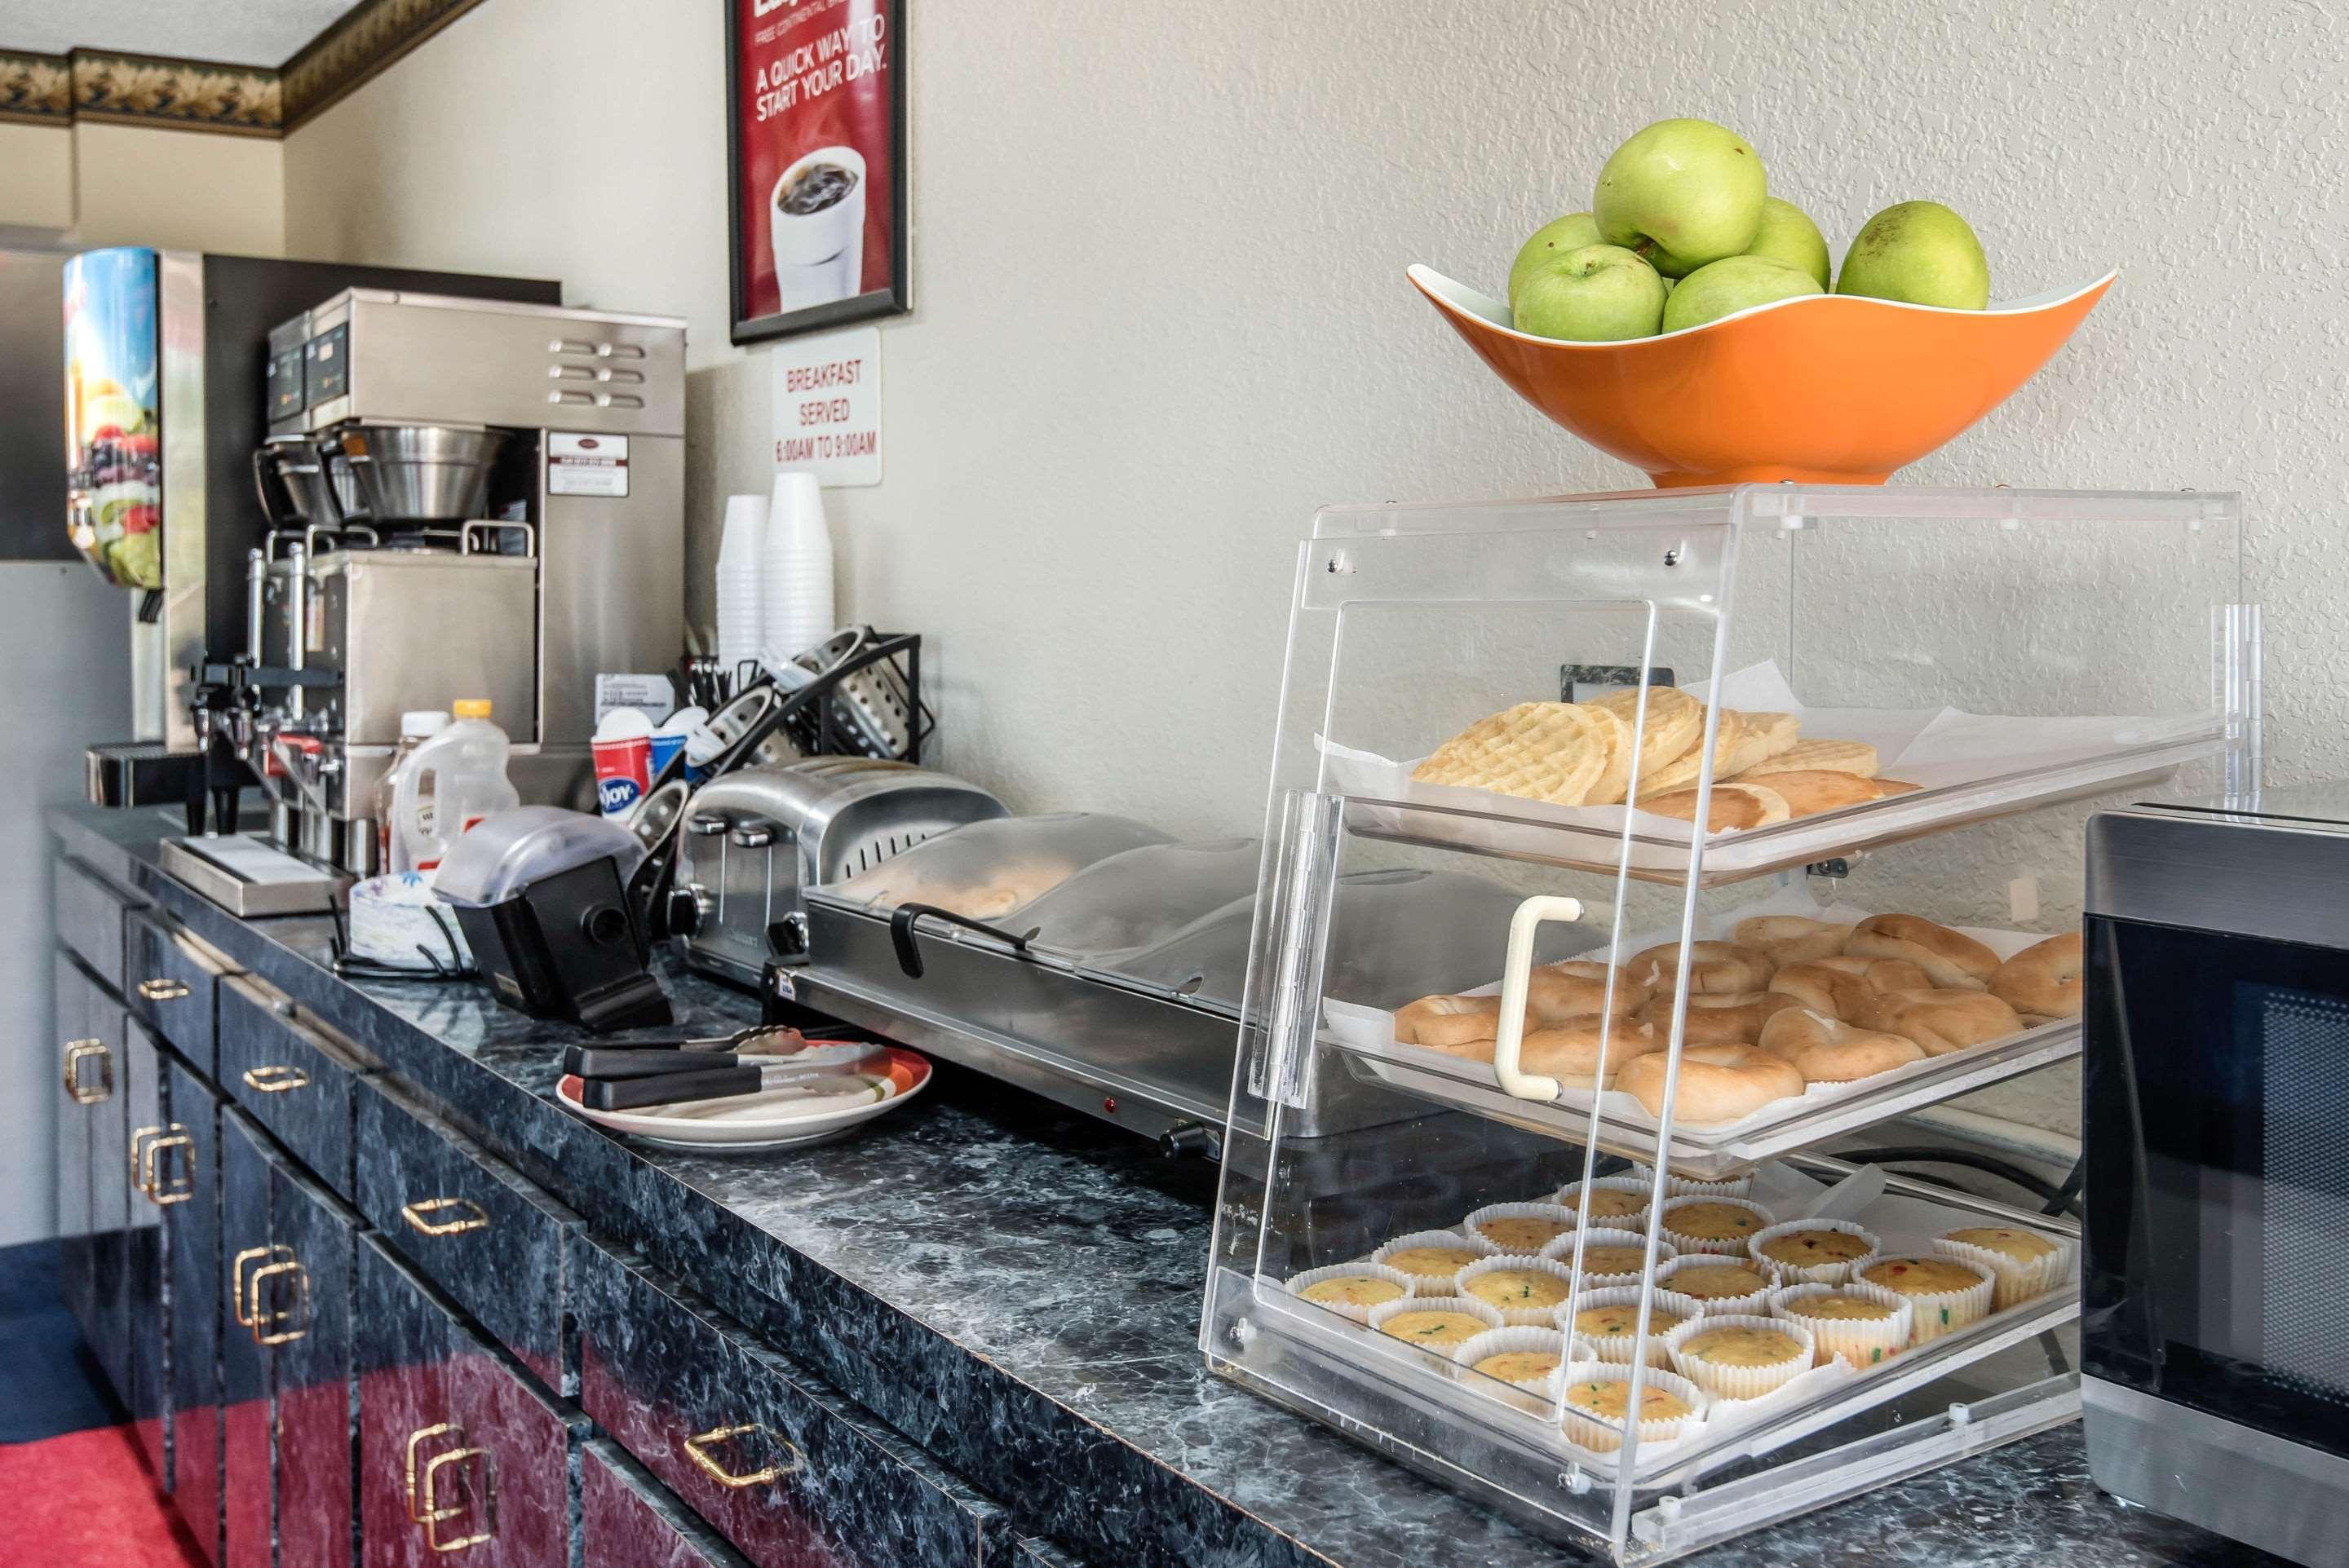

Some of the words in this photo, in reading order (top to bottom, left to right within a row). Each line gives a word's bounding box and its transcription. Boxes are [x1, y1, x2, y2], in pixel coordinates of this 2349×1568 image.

[755, 67, 769, 94] A
[771, 44, 815, 86] QUICK
[817, 28, 851, 61] WAY
[859, 13, 886, 42] TO
[756, 79, 798, 121] START
[801, 60, 843, 99] YOUR
[845, 43, 887, 81] DAY.
[787, 360, 861, 392] BREAKFAST
[800, 398, 850, 426] SERVED
[817, 435, 833, 458] TO
